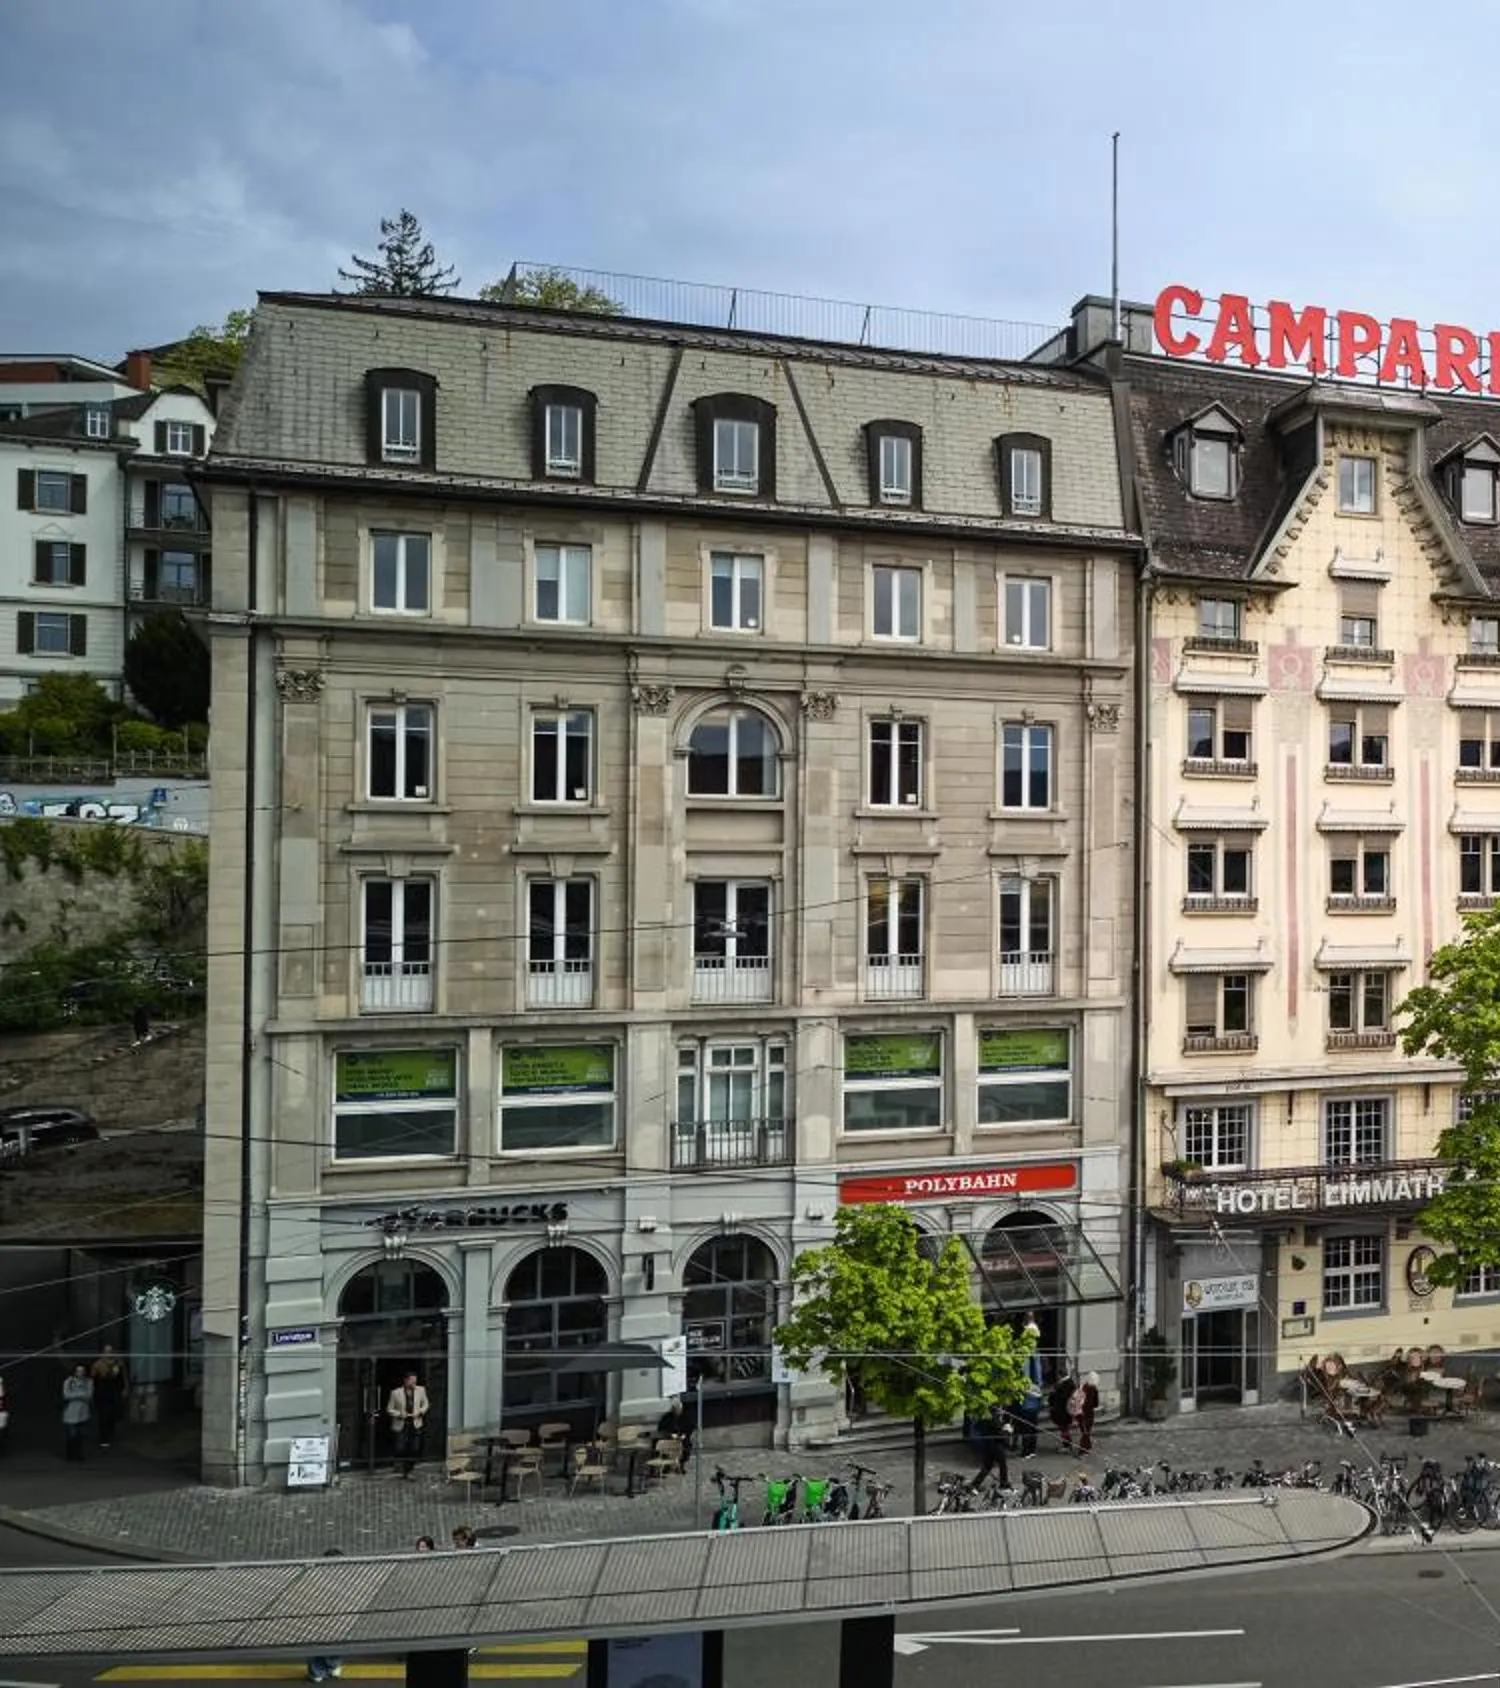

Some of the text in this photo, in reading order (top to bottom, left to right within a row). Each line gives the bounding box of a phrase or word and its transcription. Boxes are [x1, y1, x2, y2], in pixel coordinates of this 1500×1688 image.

[904, 1173, 1018, 1195] POLYBAHN
[1217, 1184, 1307, 1214] HOTEL
[1325, 1175, 1444, 1206] LIMMATH
